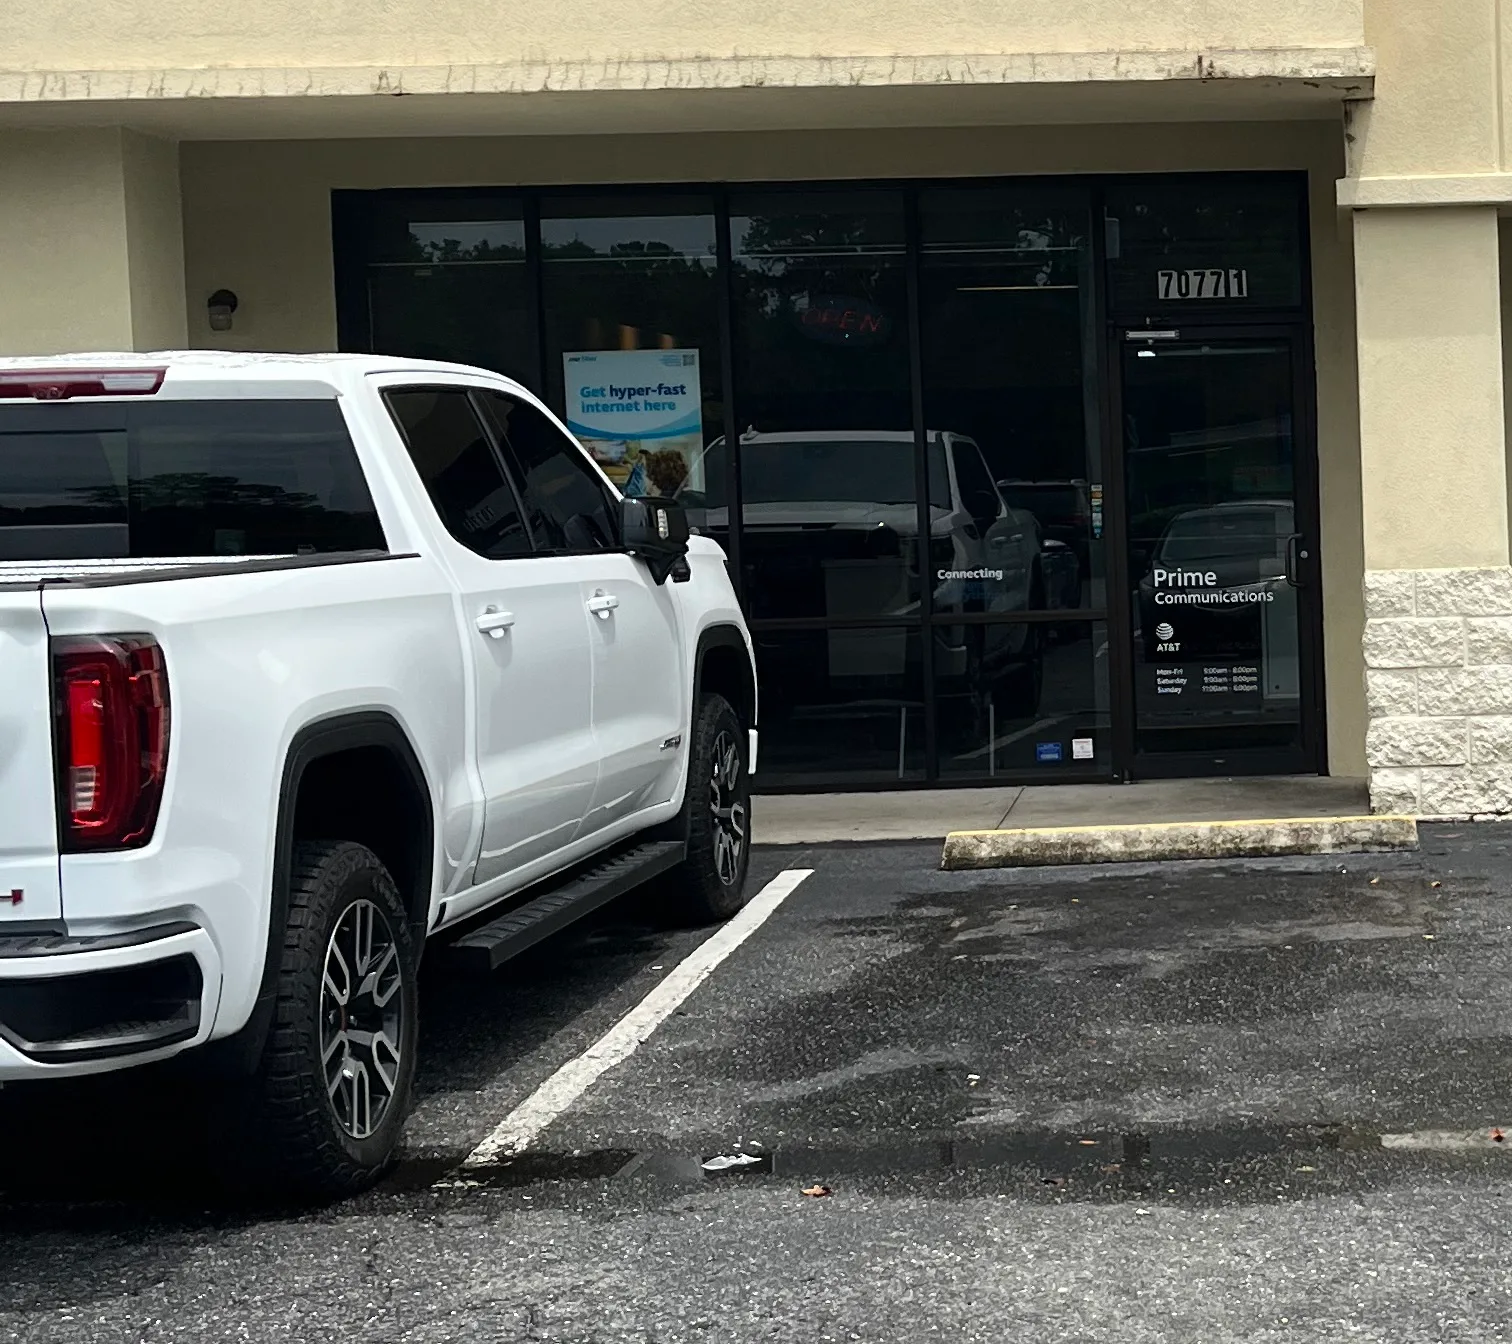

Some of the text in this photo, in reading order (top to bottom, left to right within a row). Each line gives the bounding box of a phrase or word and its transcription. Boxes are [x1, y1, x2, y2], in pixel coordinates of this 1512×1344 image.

[1160, 270, 1246, 298] 70771
[580, 383, 686, 400] Get hyper-fast
[581, 400, 676, 413] internet here
[937, 568, 1003, 580] Connecting
[1154, 567, 1217, 587] Prime
[1155, 590, 1274, 605] Communications
[1157, 642, 1181, 652] AT&T
[1157, 677, 1188, 686] Saturday
[1157, 686, 1182, 694] Sunday
